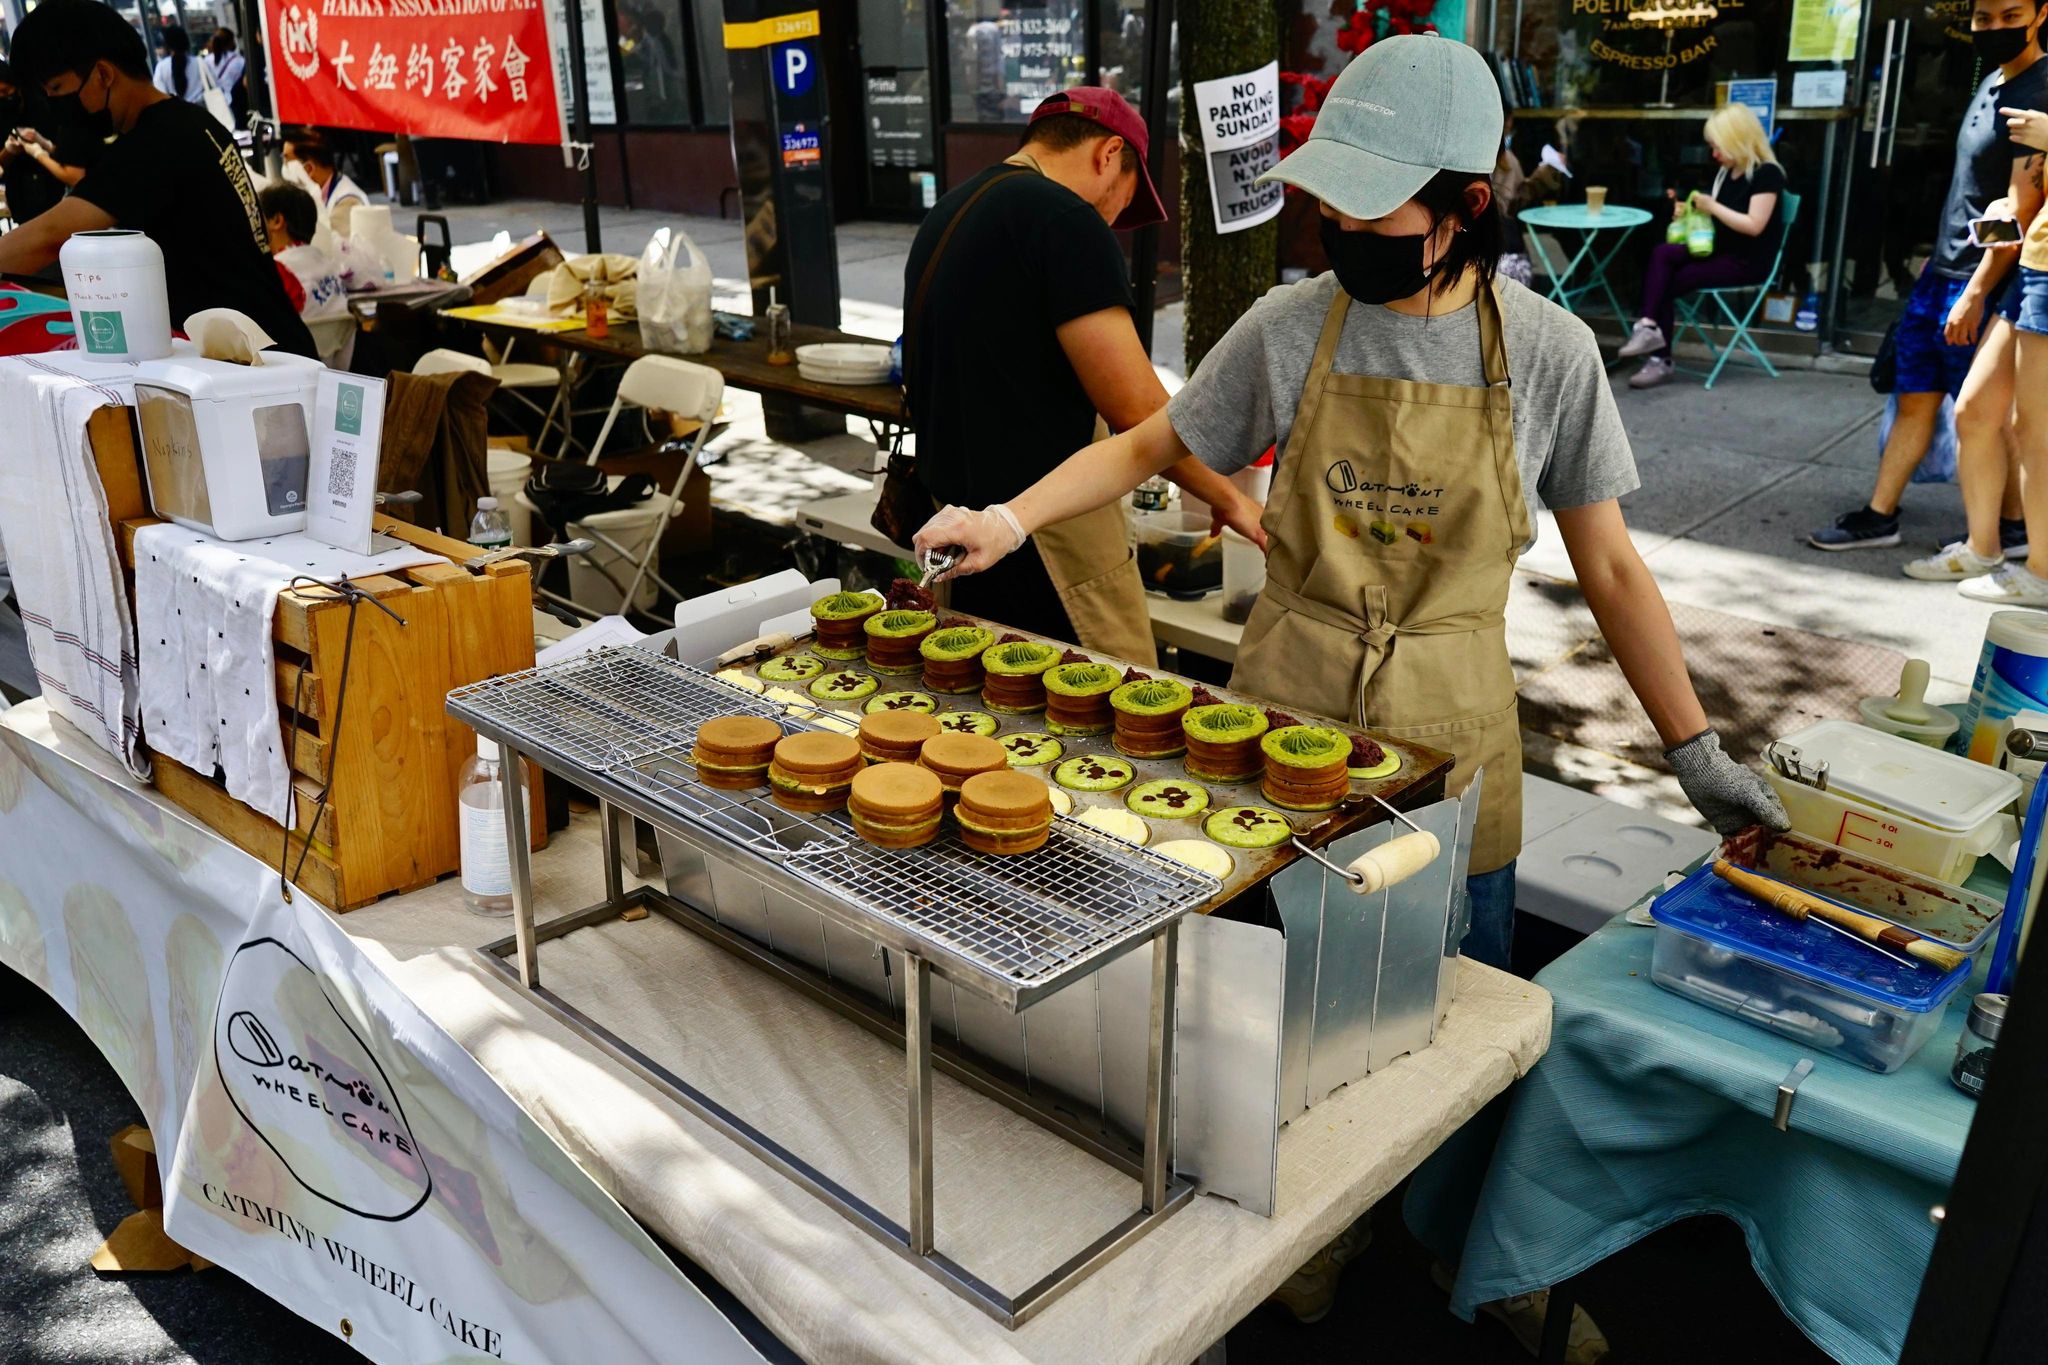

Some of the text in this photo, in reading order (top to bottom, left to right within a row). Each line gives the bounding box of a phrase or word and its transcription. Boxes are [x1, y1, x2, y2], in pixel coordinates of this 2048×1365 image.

[322, 0, 383, 16] HAKKA
[389, 0, 487, 16] ASSOCIATION
[1589, 35, 1718, 70] ESPRESSO BAR
[330, 34, 531, 103] 大紐約客家會
[786, 48, 807, 89] P
[1232, 82, 1256, 100] NO
[1210, 91, 1274, 122] PARKING
[1356, 100, 1397, 117] DIRECTOR
[1216, 110, 1274, 138] SUNDAY
[1229, 142, 1273, 167] AVOID
[74, 273, 102, 283] Tips
[1333, 497, 1440, 516] WHEEL CAKE
[1888, 825, 1898, 834] Qt
[1883, 840, 1894, 848] Qt
[252, 1073, 412, 1156] WHEEL CAKE
[202, 1183, 502, 1359] CATMINT WHEEL CAKE
